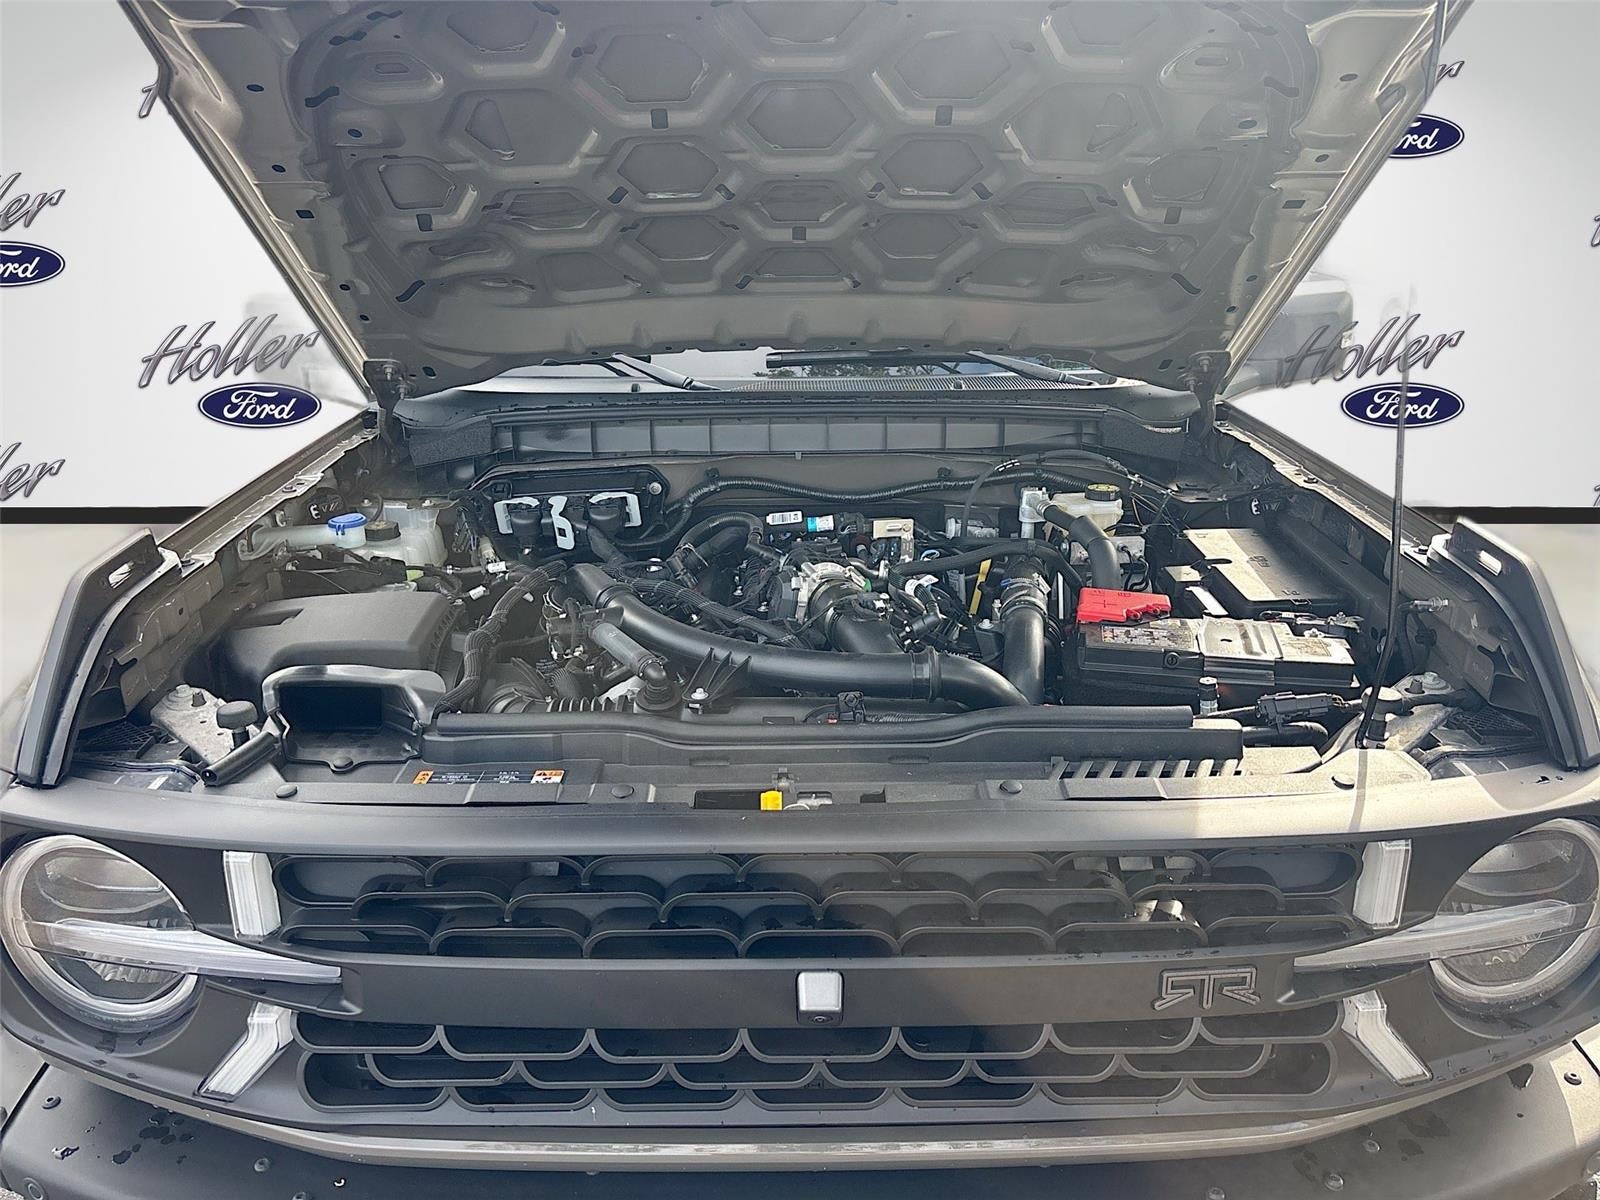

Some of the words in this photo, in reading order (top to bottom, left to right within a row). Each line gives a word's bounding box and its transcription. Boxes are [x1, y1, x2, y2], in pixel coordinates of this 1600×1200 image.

[138, 313, 321, 389] Holler
[1281, 313, 1466, 389] Holler
[223, 389, 298, 420] Ford
[1365, 389, 1440, 420] Ford
[1153, 966, 1261, 1011] RTR
